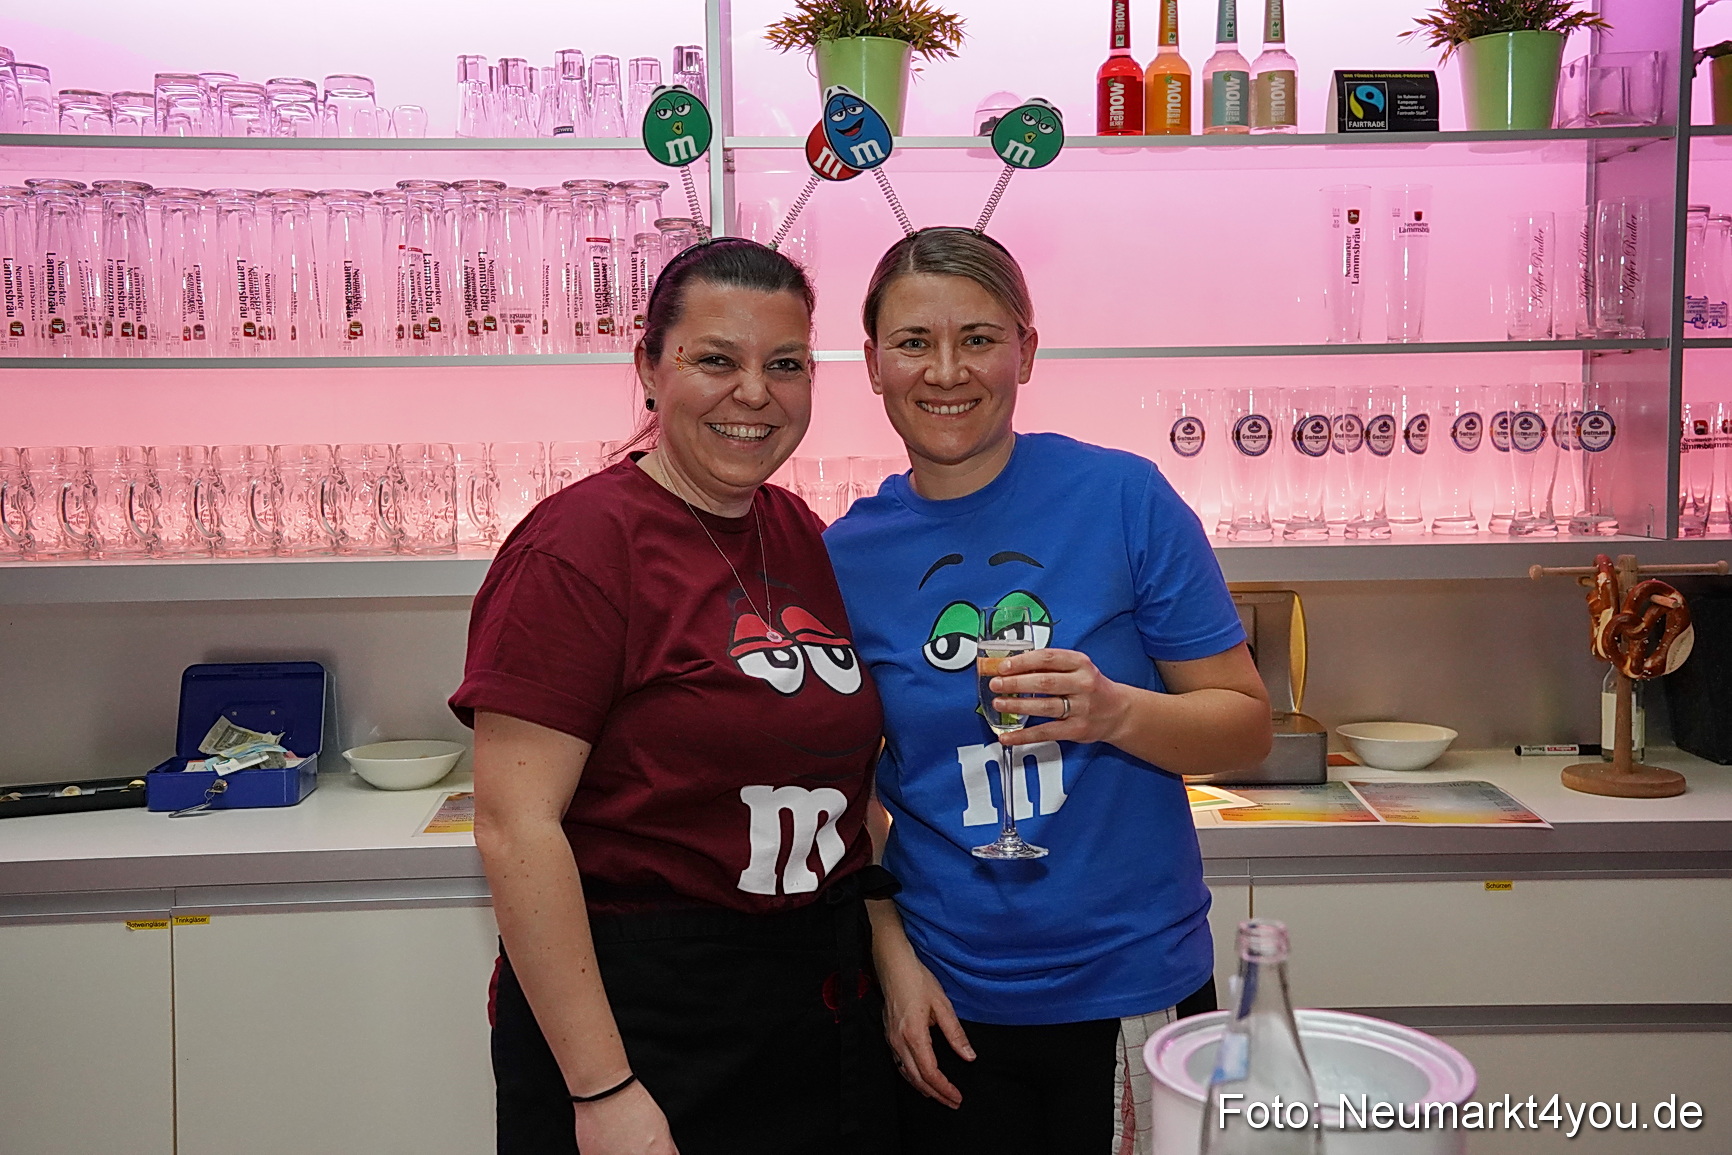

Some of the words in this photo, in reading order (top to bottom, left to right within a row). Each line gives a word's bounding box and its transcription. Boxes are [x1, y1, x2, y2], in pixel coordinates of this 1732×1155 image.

[1115, 2, 1125, 24] now
[1109, 82, 1125, 115] now
[1166, 79, 1182, 112] now
[1225, 75, 1240, 108] now
[1270, 75, 1285, 109] now
[1348, 120, 1385, 128] FAIRTRADE
[665, 135, 699, 164] m
[813, 146, 843, 180] m
[849, 139, 886, 166] m
[1001, 139, 1036, 168] m
[1351, 227, 1361, 285] Lammsbräu
[1530, 228, 1545, 269] Radler
[1622, 214, 1638, 257] Radler
[3, 257, 17, 318] Lammsbräu
[15, 265, 24, 310] Neumarkter
[46, 252, 58, 314] Lammsbräu
[57, 260, 67, 307] Neumarkter
[116, 259, 128, 319] Lammsbräu
[236, 259, 250, 319] Lammsbräu
[422, 253, 435, 314] Lammsbräu
[433, 260, 442, 306] Neumarkter
[477, 251, 490, 312] Lammsbräu
[488, 259, 497, 304] Neumarkter
[592, 256, 604, 316] Lammsbräu
[630, 251, 641, 311] Lammsbräu
[957, 740, 1069, 827] m
[737, 785, 848, 895] m
